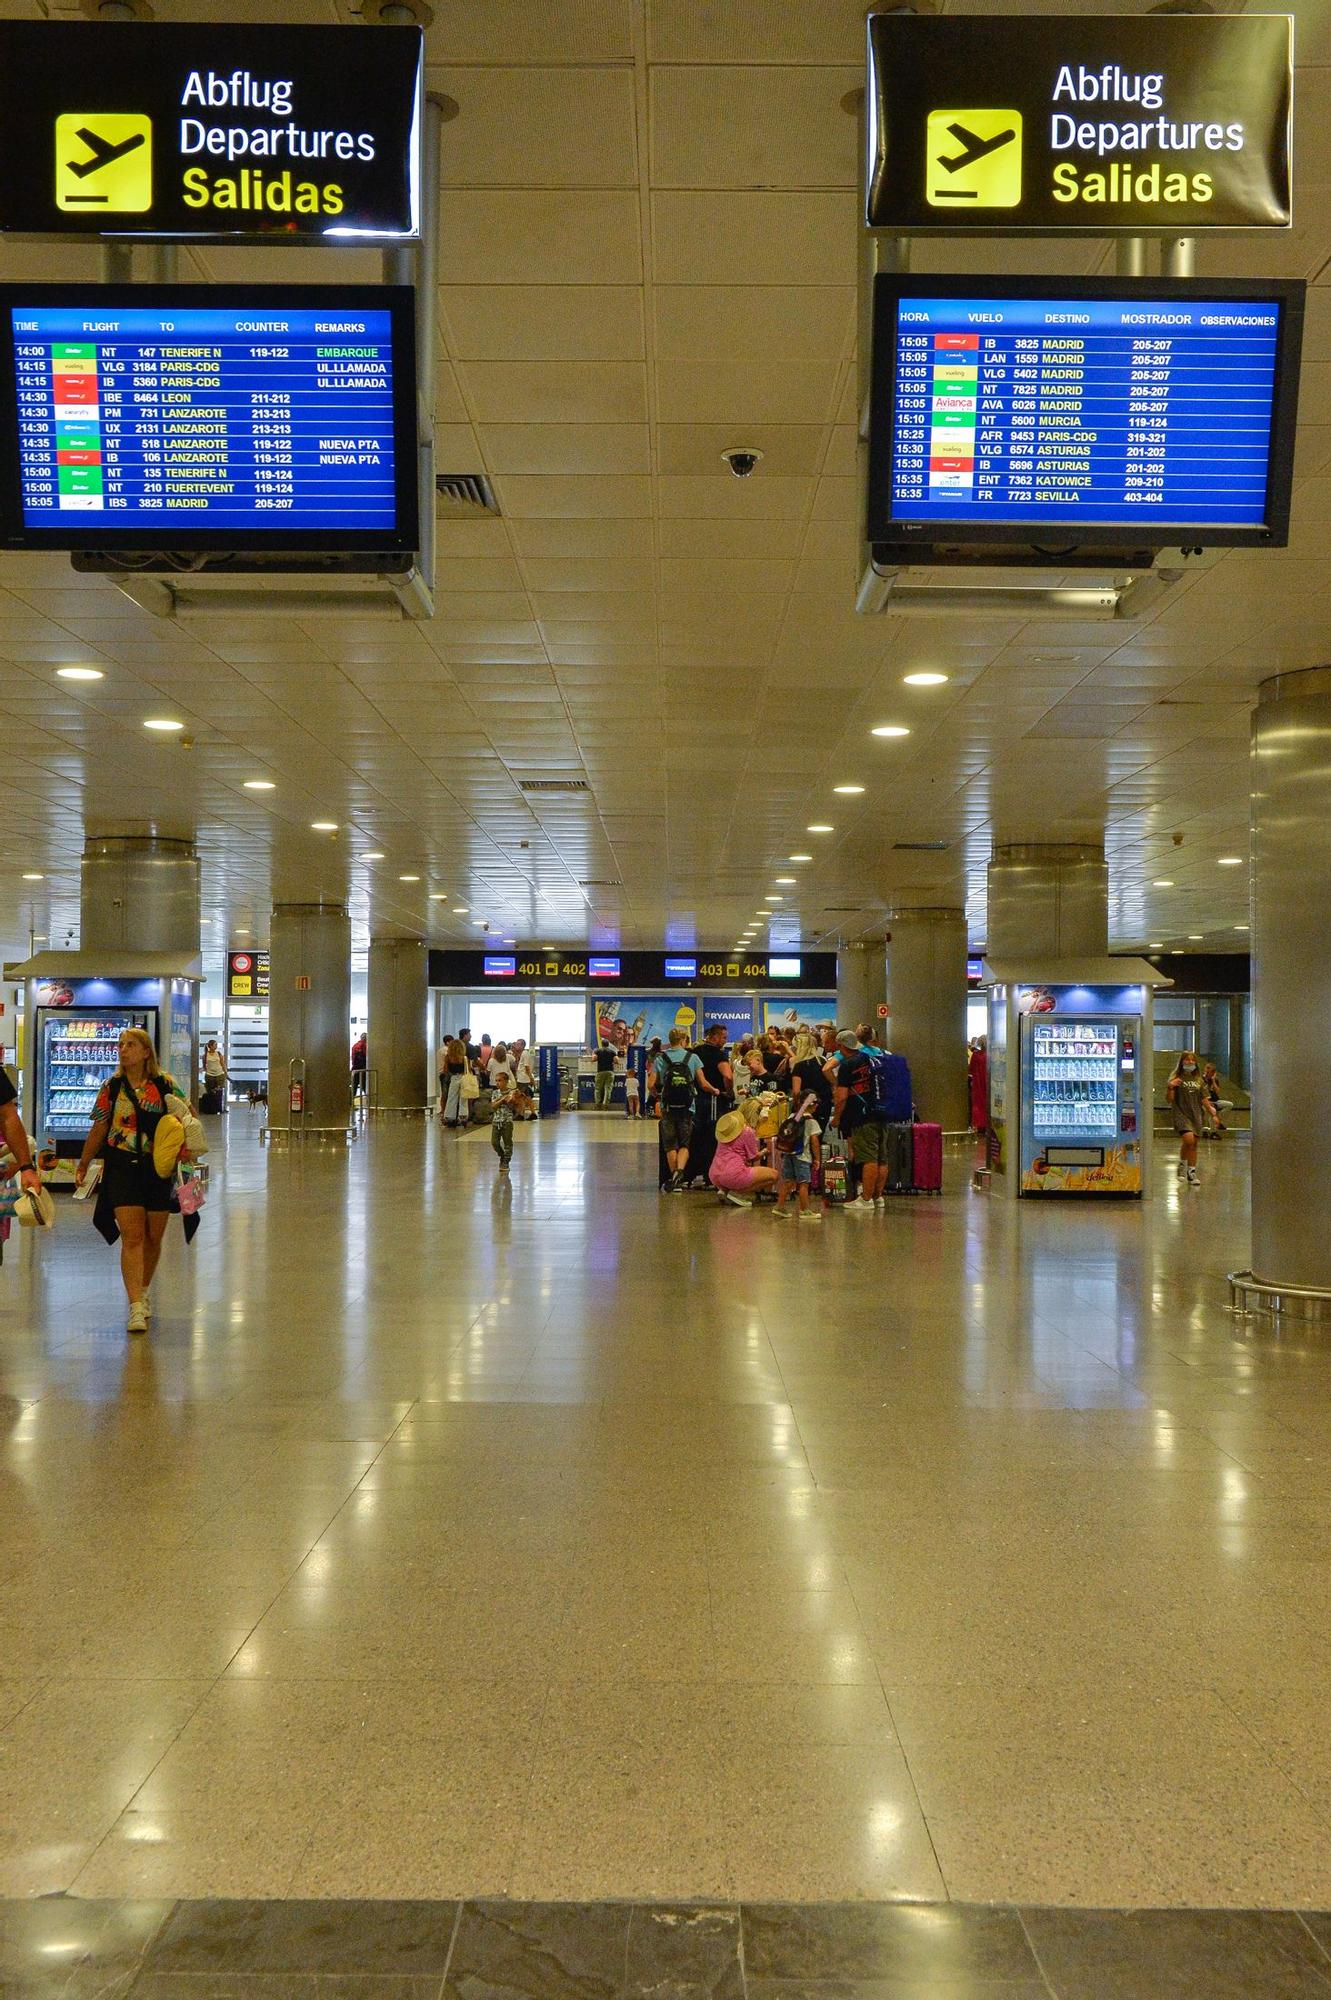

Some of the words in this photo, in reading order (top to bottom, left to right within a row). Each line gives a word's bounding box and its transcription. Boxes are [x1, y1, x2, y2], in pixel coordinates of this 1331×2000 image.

[1052, 66, 1163, 108] Abflug
[181, 71, 293, 115] Abflug
[180, 118, 375, 161] Departures
[1050, 114, 1244, 155] Departures
[1052, 163, 1213, 202] Salidas
[182, 167, 345, 215] Salidas
[900, 313, 929, 321] HORA
[969, 314, 1003, 322] VUELO
[1045, 314, 1090, 323] DESTINO
[1122, 315, 1191, 324] MOSTRADOR
[1201, 317, 1275, 325] OBSERVACIONES
[15, 322, 38, 330] TIME
[83, 323, 119, 331] FLIGHT
[236, 322, 288, 331] COUNTER
[315, 323, 365, 332] REMARKS
[901, 338, 927, 346] 15:05
[1043, 340, 1084, 349] MADRID
[1133, 341, 1172, 350] 205-207
[160, 349, 211, 357] TENERIFE
[215, 349, 221, 357] N
[250, 349, 288, 357] 119-122
[317, 348, 378, 357] EMBARQUE
[985, 355, 1006, 363] LAN
[1015, 355, 1038, 363] 1559
[1042, 355, 1084, 364] MADRID
[1132, 356, 1171, 364] 205-207
[160, 363, 219, 371] PARIS-CDG
[984, 370, 1005, 378] VLG
[1014, 370, 1037, 378] 5402
[1042, 370, 1083, 379] MADRID
[1131, 371, 1170, 380] 205-207
[161, 378, 219, 386] PARIS-CDG
[983, 385, 997, 394] NT
[1013, 386, 1036, 394] 7825
[1041, 386, 1082, 394] MADRID
[1130, 387, 1169, 396] 205-207
[104, 394, 122, 402] IBE
[162, 394, 191, 402] LEON
[251, 395, 290, 403] 211-212
[898, 400, 925, 408] 15:05
[936, 398, 972, 407] Avianca
[982, 401, 1003, 409] AVA
[1040, 401, 1081, 410] MADRID
[1130, 403, 1168, 411] 205-207
[140, 409, 158, 417] 731
[162, 409, 226, 418] LANZAROTE
[252, 410, 290, 418] 213-213
[982, 416, 995, 424] NT
[1012, 417, 1035, 425] 5600
[1039, 417, 1080, 426] MURCIA
[1129, 418, 1167, 427] 119-124
[106, 424, 120, 432] UX
[135, 424, 158, 433] 2131
[163, 425, 227, 433] LANZAROTE
[252, 425, 291, 433] 213-213
[981, 432, 1002, 440] AFR
[1011, 432, 1034, 441] 9453
[1038, 433, 1096, 441] PARIS-CDG
[106, 439, 120, 448] NT
[142, 439, 159, 448] 518
[164, 440, 228, 448] LANZAROTE
[253, 440, 291, 449] 119-122
[319, 441, 355, 449] NUEVA
[359, 441, 379, 449] PTA
[897, 445, 923, 453] 15:30
[981, 446, 1002, 454] VLG
[1010, 446, 1033, 454] 6574
[1037, 446, 1090, 455] ASTURIAS
[1127, 448, 1165, 456] 201-202
[107, 454, 118, 462] IB
[143, 454, 160, 462] 106
[164, 454, 228, 462] LANZAROTE
[254, 454, 292, 463] 119-122
[320, 455, 355, 464] NUEVA
[359, 455, 380, 464] PTA
[896, 460, 922, 468] 15:30
[980, 461, 990, 469] IB
[1036, 461, 1089, 470] ASTURIAS
[1126, 464, 1164, 473] 201-202
[108, 469, 122, 477] NT
[143, 469, 161, 477] 135
[165, 469, 216, 477] TENERIFE
[220, 469, 226, 478] N
[254, 471, 293, 479] 119-124
[896, 475, 922, 483] 15:35
[979, 476, 1000, 484] ENT
[1009, 476, 1032, 485] 7362
[1036, 476, 1091, 486] KATOWICE
[1125, 478, 1163, 486] 209-210
[25, 483, 51, 491] 15:00
[109, 484, 122, 492] NT
[144, 484, 161, 492] 210
[166, 484, 234, 492] FUERTEVENT
[255, 484, 293, 493] 119-124
[895, 489, 921, 498] 15:35
[979, 491, 992, 500] FR
[1008, 491, 1031, 500] 7723
[1035, 492, 1079, 501] SEVILLA
[1124, 493, 1162, 502] 403-404
[25, 498, 52, 506] 15:05
[109, 499, 127, 507] IBS
[139, 499, 162, 507] 3825
[167, 499, 208, 508] MADRID
[255, 499, 293, 508] 205-207
[519, 964, 541, 975] 401
[562, 964, 586, 975] 402
[700, 964, 722, 976] 403
[743, 964, 766, 976] 404
